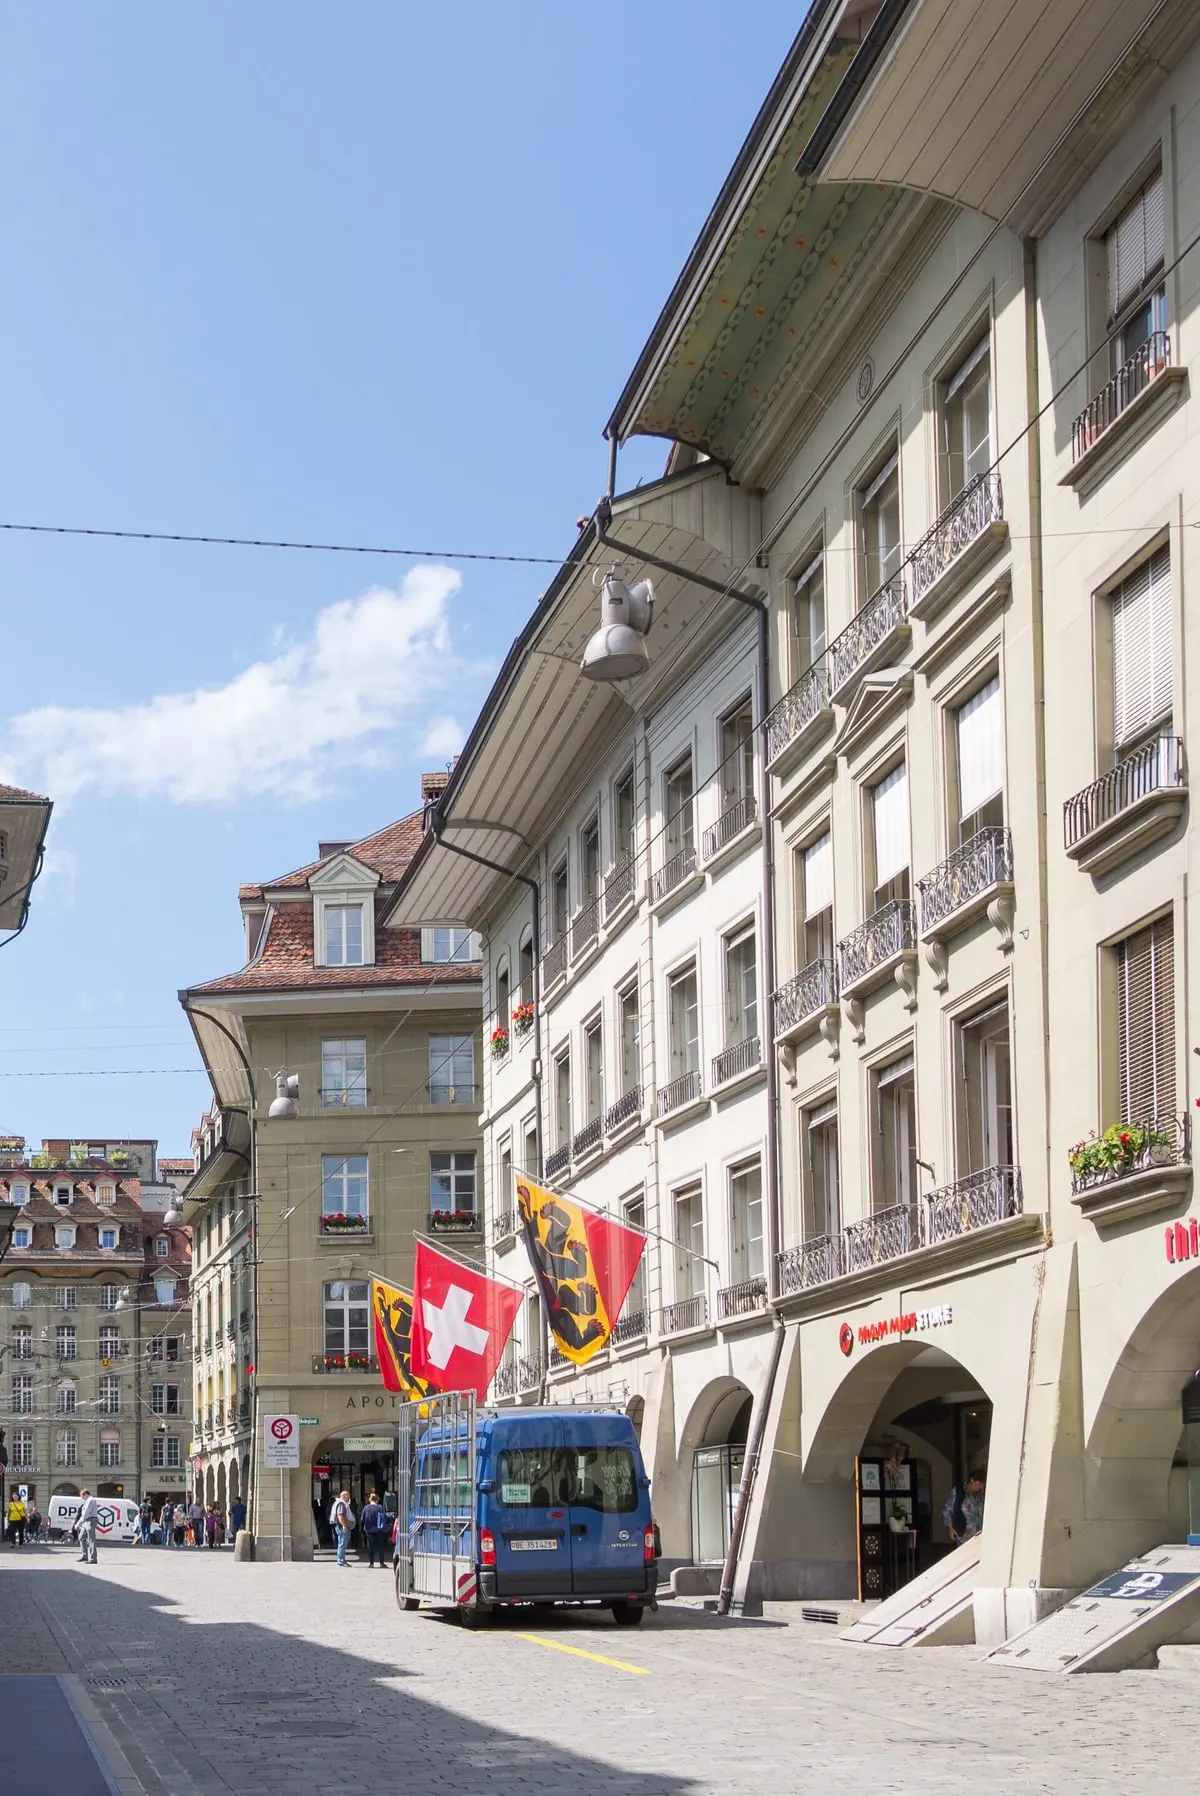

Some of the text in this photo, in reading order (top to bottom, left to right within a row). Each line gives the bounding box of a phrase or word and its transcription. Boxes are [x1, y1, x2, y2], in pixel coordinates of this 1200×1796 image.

[1165, 1217, 1200, 1263] thi
[858, 1303, 953, 1343] MAMMUT STORE
[58, 1506, 78, 1517] DP
